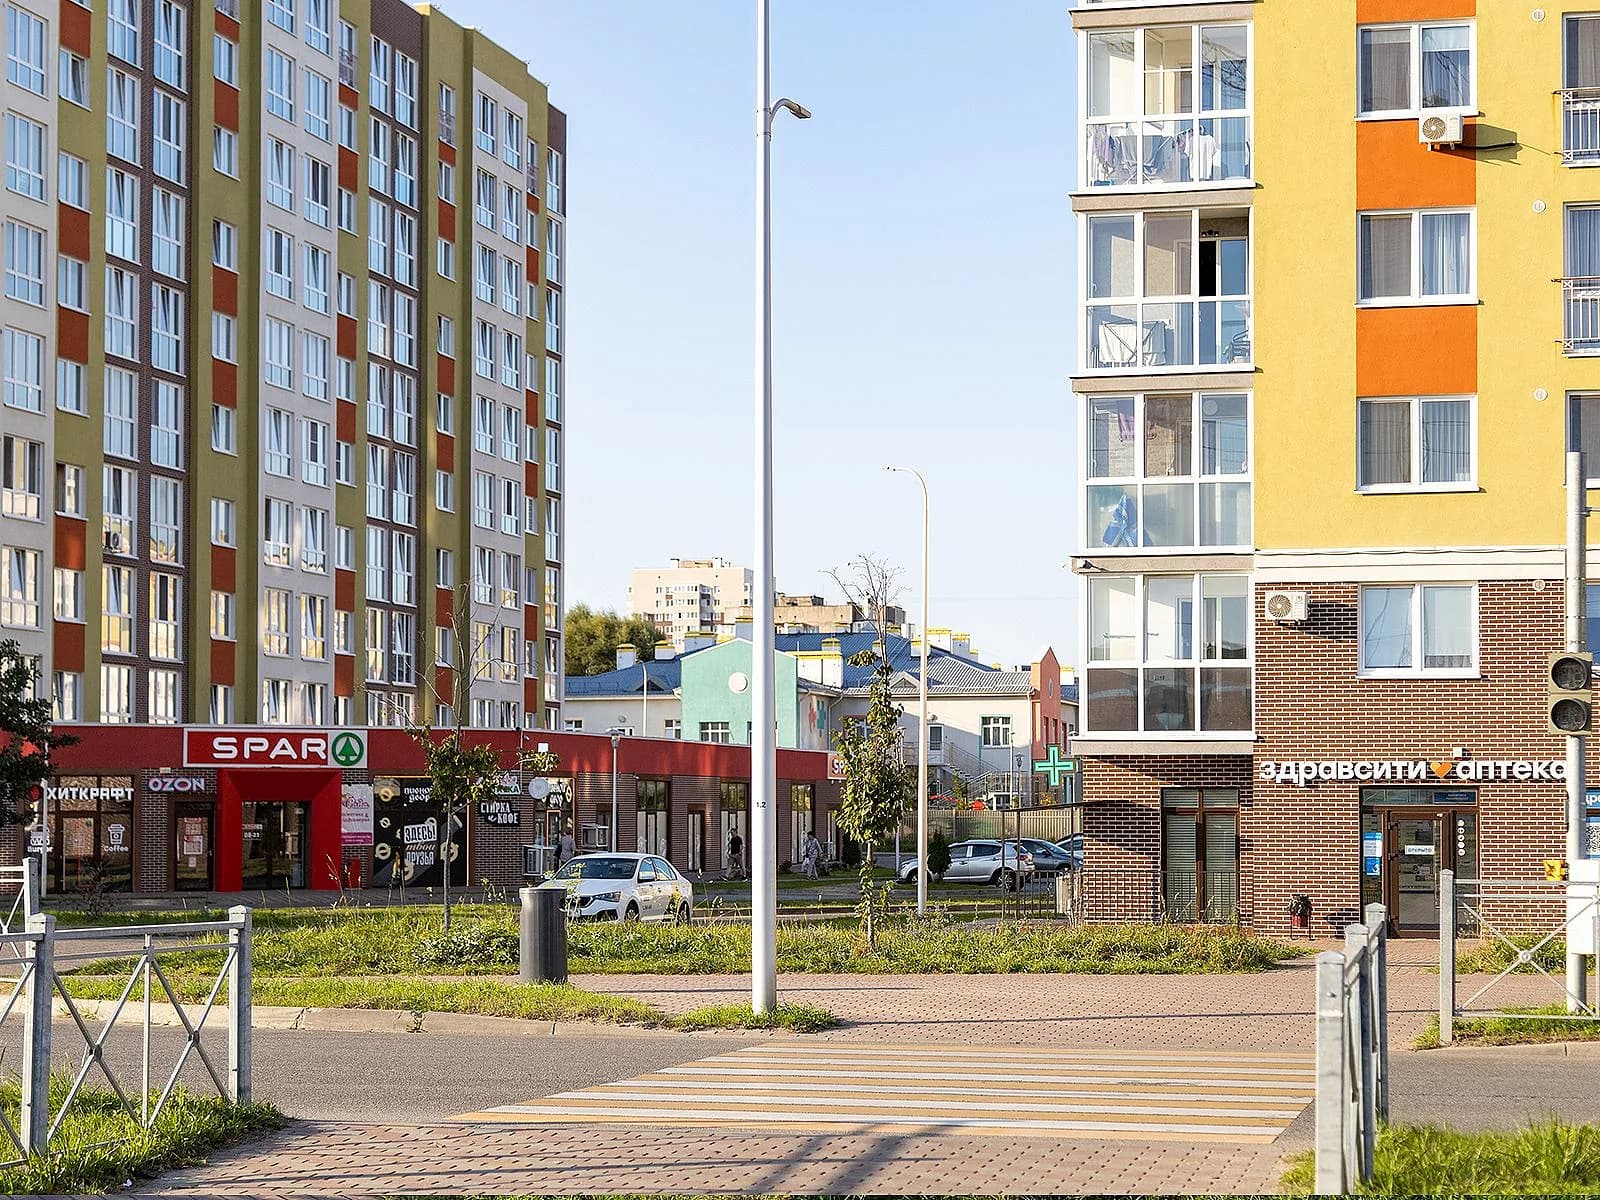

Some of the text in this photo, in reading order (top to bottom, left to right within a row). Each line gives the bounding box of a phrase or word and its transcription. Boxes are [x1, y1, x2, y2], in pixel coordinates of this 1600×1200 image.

[212, 736, 326, 760] SPAR
[1259, 761, 1567, 788] здравсити аптека
[149, 777, 205, 791] OZON
[404, 786, 433, 795] пивно
[47, 787, 134, 800] ХИТКРАФТ
[497, 813, 519, 824] КОФЕ
[405, 826, 436, 843] ЗДЕСЬ!
[103, 845, 129, 853] Coffee
[406, 851, 434, 865] ДРУЗЬЯ
